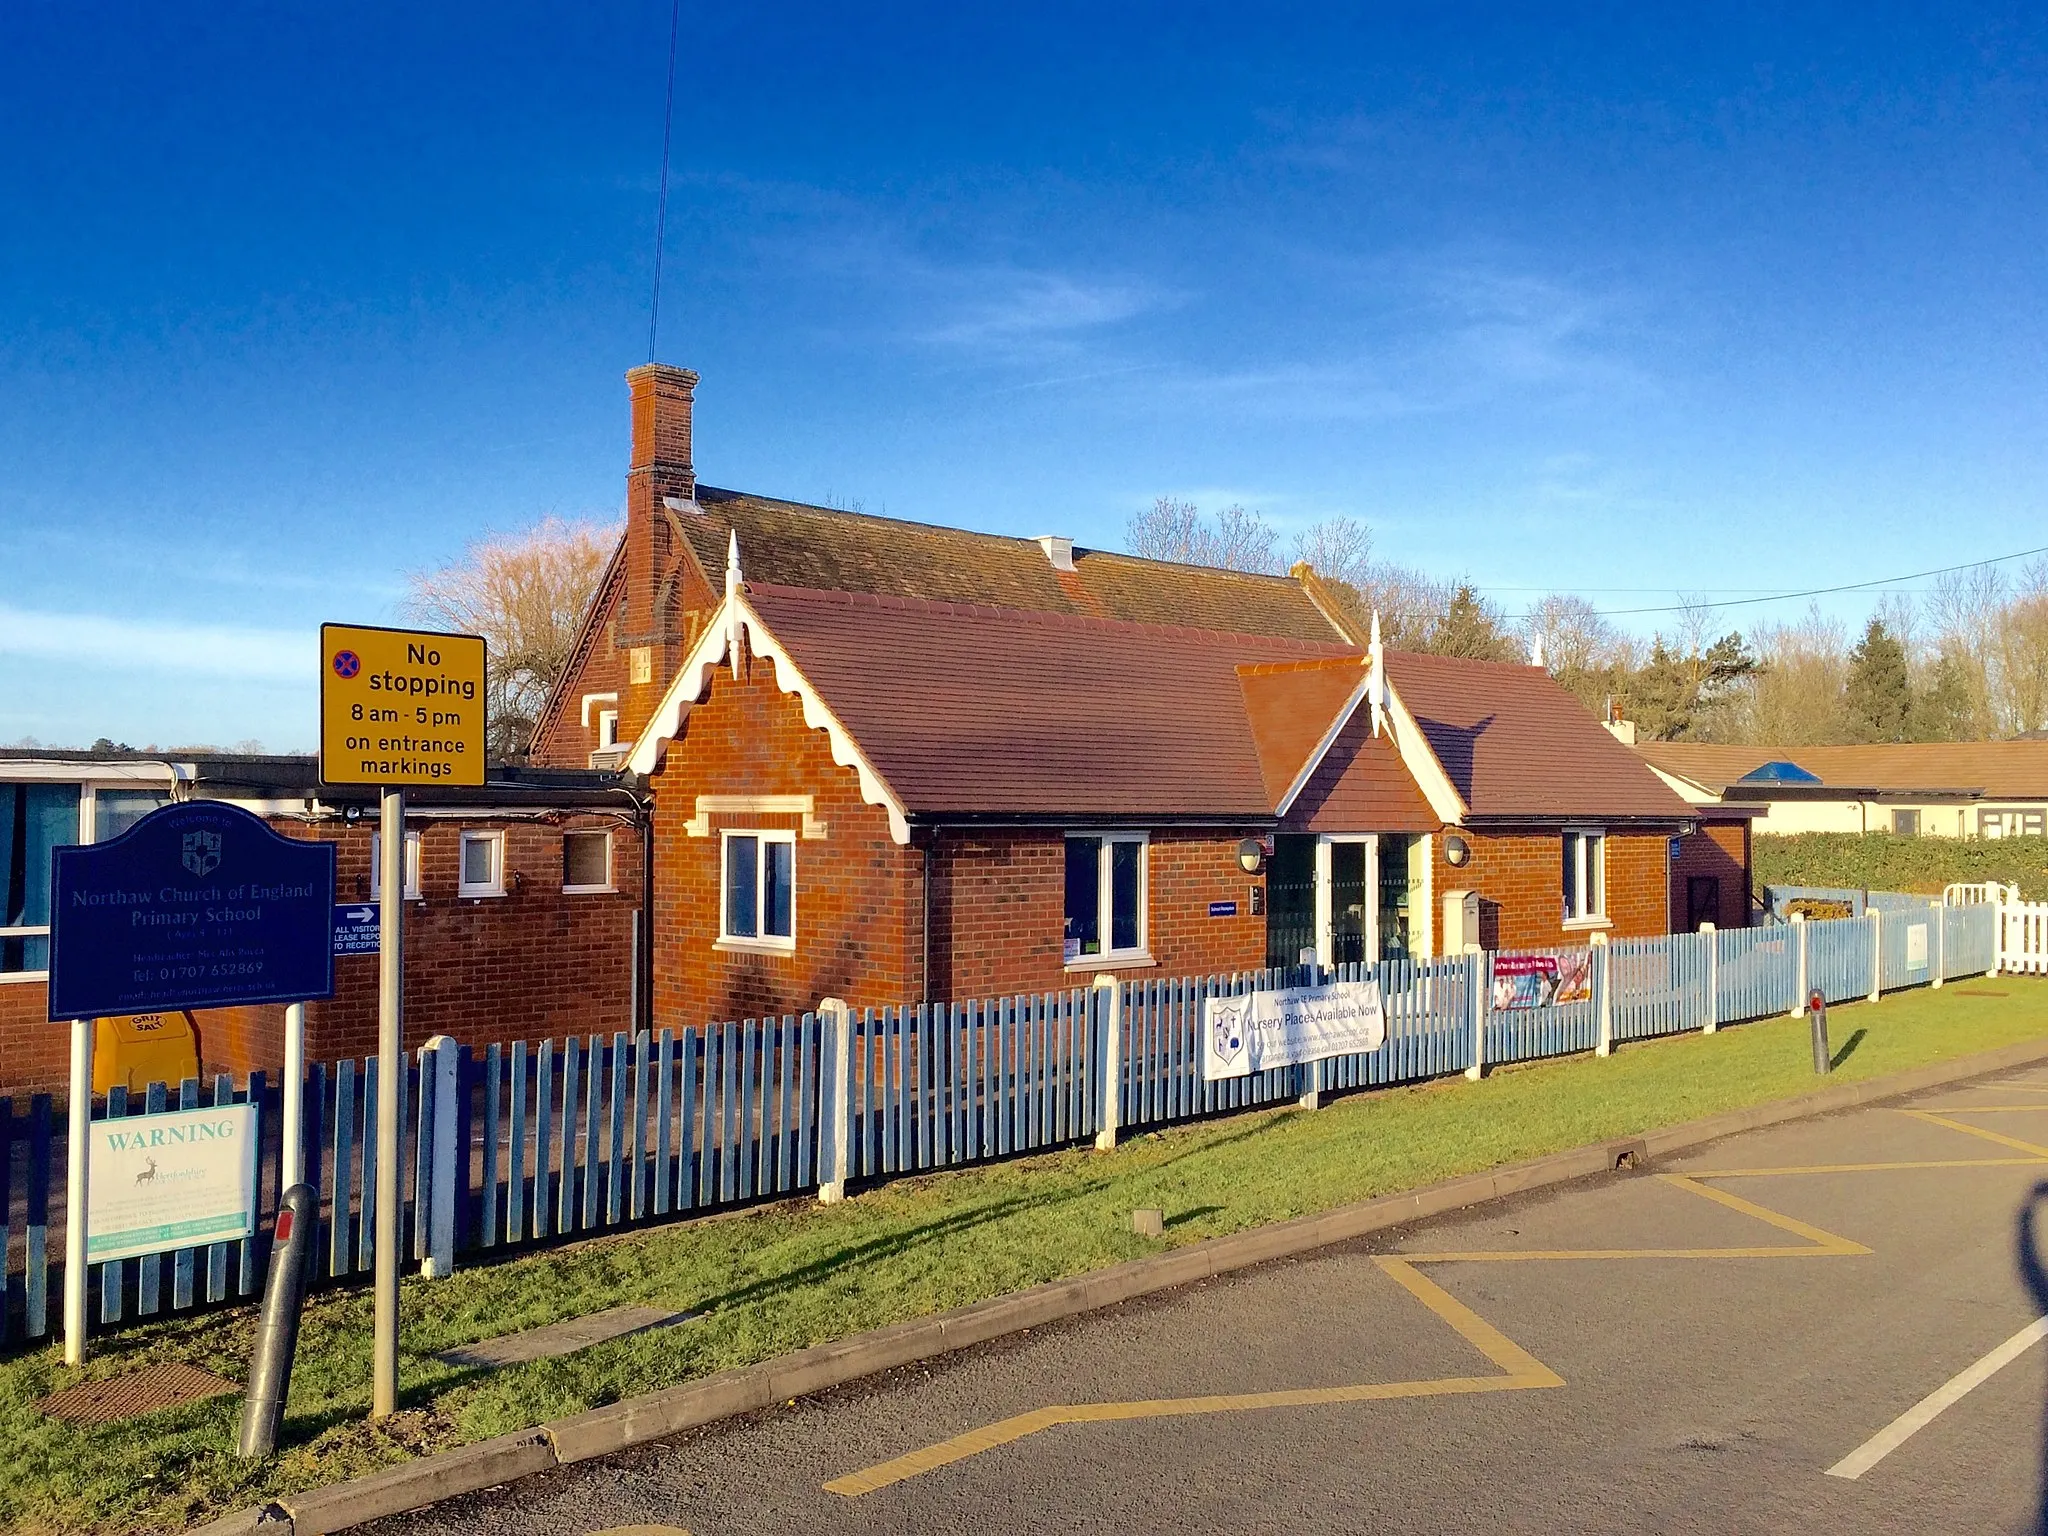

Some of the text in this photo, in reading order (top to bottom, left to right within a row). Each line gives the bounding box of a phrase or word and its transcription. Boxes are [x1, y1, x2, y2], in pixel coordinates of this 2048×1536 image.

[408, 644, 441, 666] No
[369, 671, 475, 700] stopping
[369, 708, 398, 722] am
[432, 712, 461, 727] pm
[345, 735, 465, 753] on entrance
[361, 758, 452, 778] markings
[72, 882, 314, 907] Northaw Church of England
[132, 906, 261, 926] Primary School
[335, 926, 349, 934] ALL
[132, 961, 264, 982] Tel: 01707 652869
[1274, 996, 1299, 1007] Northaw
[1309, 994, 1330, 1003] Primary
[1331, 990, 1351, 1000] School
[132, 1015, 163, 1024] GRIT
[136, 1021, 164, 1031] SALT
[1247, 1004, 1377, 1031] Nursery Places Available Now
[107, 1120, 235, 1152] WARNING
